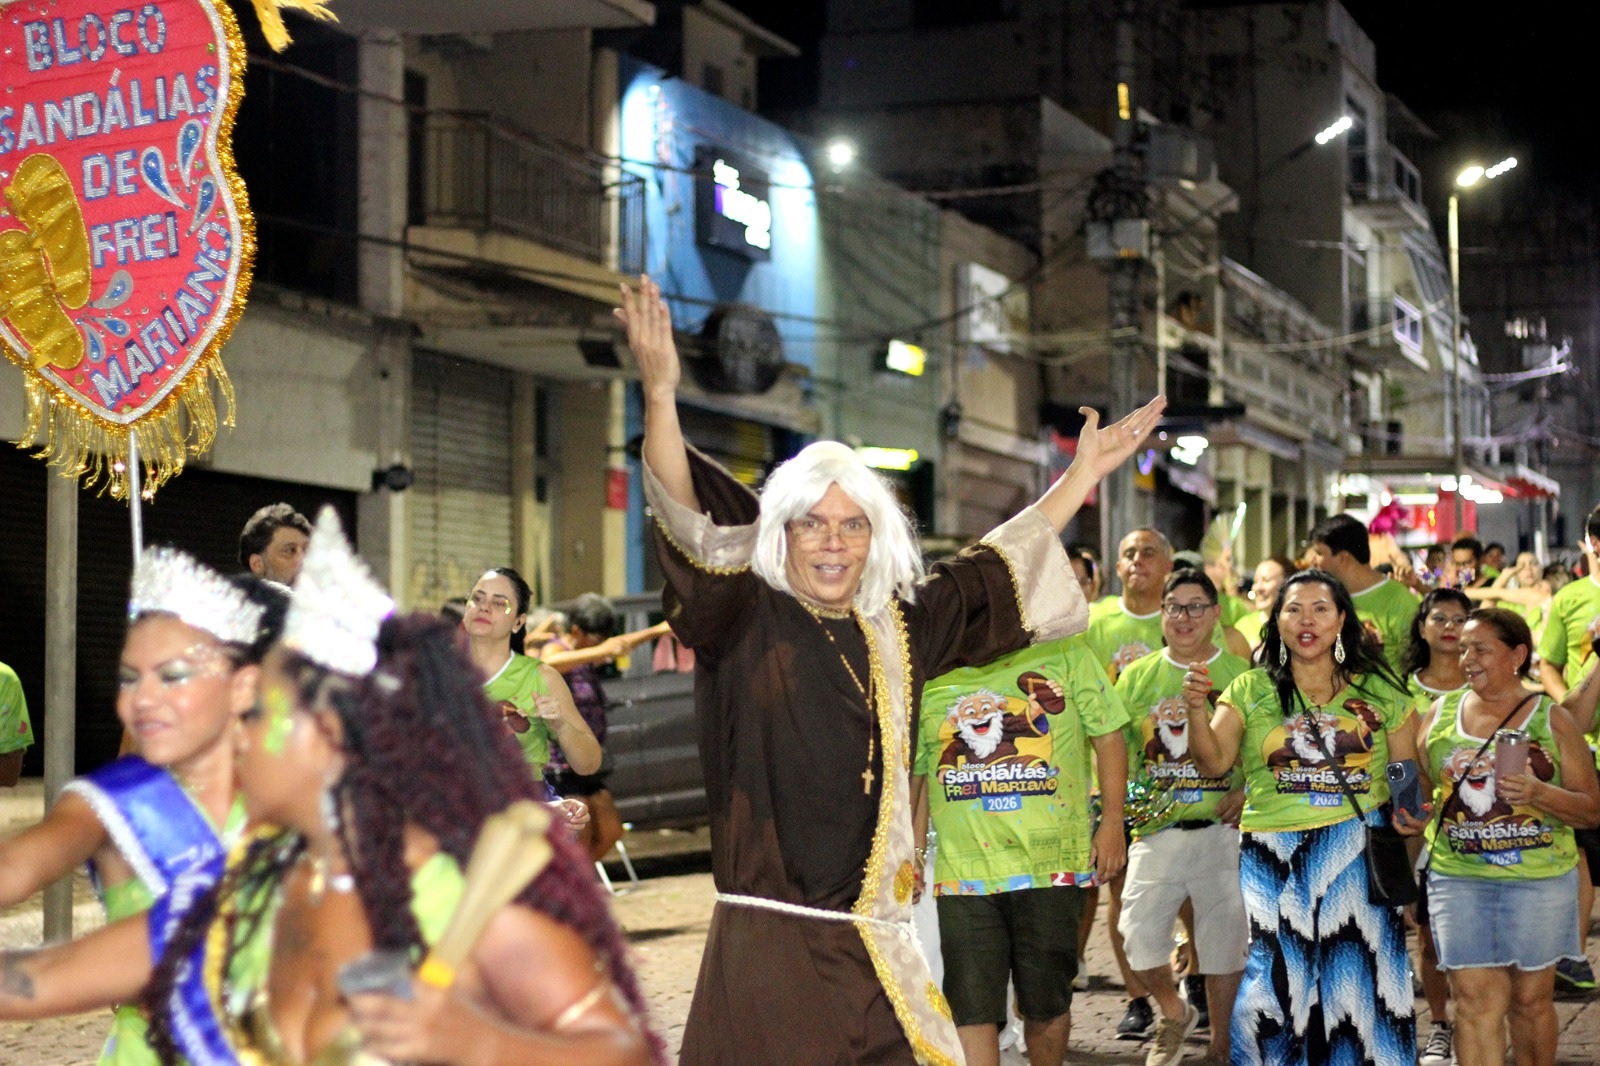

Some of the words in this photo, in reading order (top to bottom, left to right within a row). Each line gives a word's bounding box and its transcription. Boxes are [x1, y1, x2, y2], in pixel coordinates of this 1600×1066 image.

[23, 4, 167, 72] BLOCO
[0, 65, 219, 154] SANDÁLIAS
[82, 149, 138, 200] DE
[90, 211, 180, 268] FREI
[89, 220, 231, 410] MARIANO
[988, 797, 1017, 811] 2026
[1314, 794, 1339, 805] 2026
